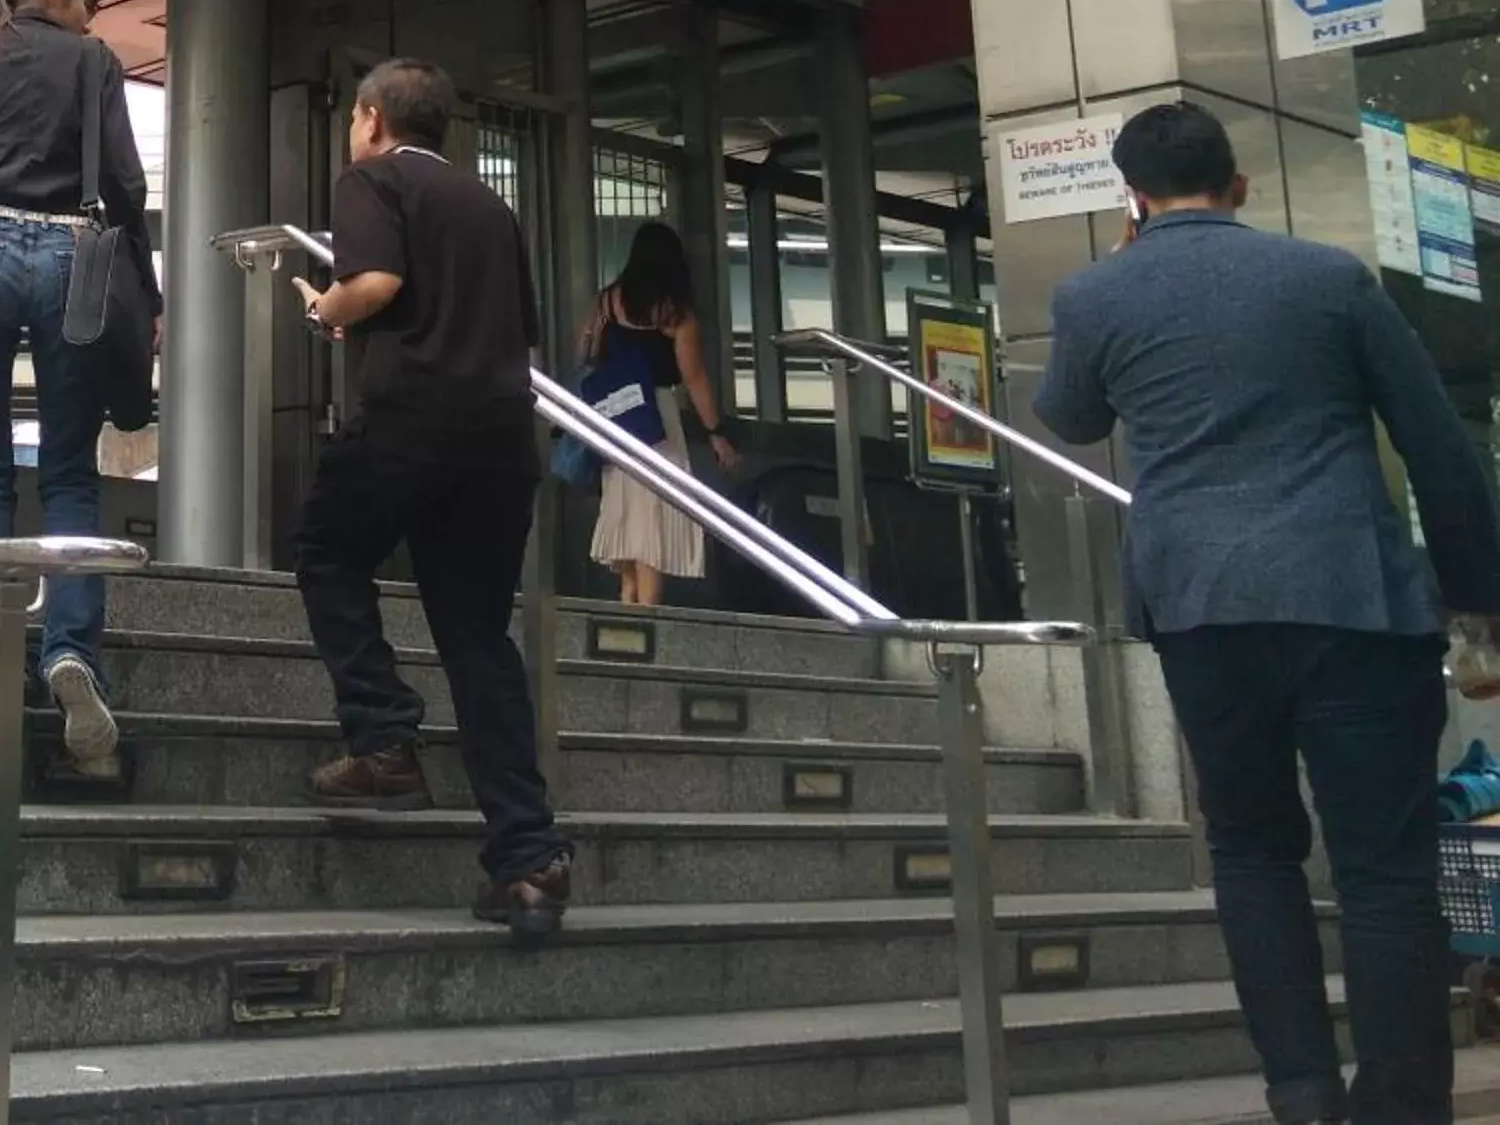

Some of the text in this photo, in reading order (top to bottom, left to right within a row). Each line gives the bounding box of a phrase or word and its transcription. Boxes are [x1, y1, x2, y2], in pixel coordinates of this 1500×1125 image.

[1312, 16, 1382, 41] MRT
[1018, 178, 1116, 200] BEWARE OF THIEVES
